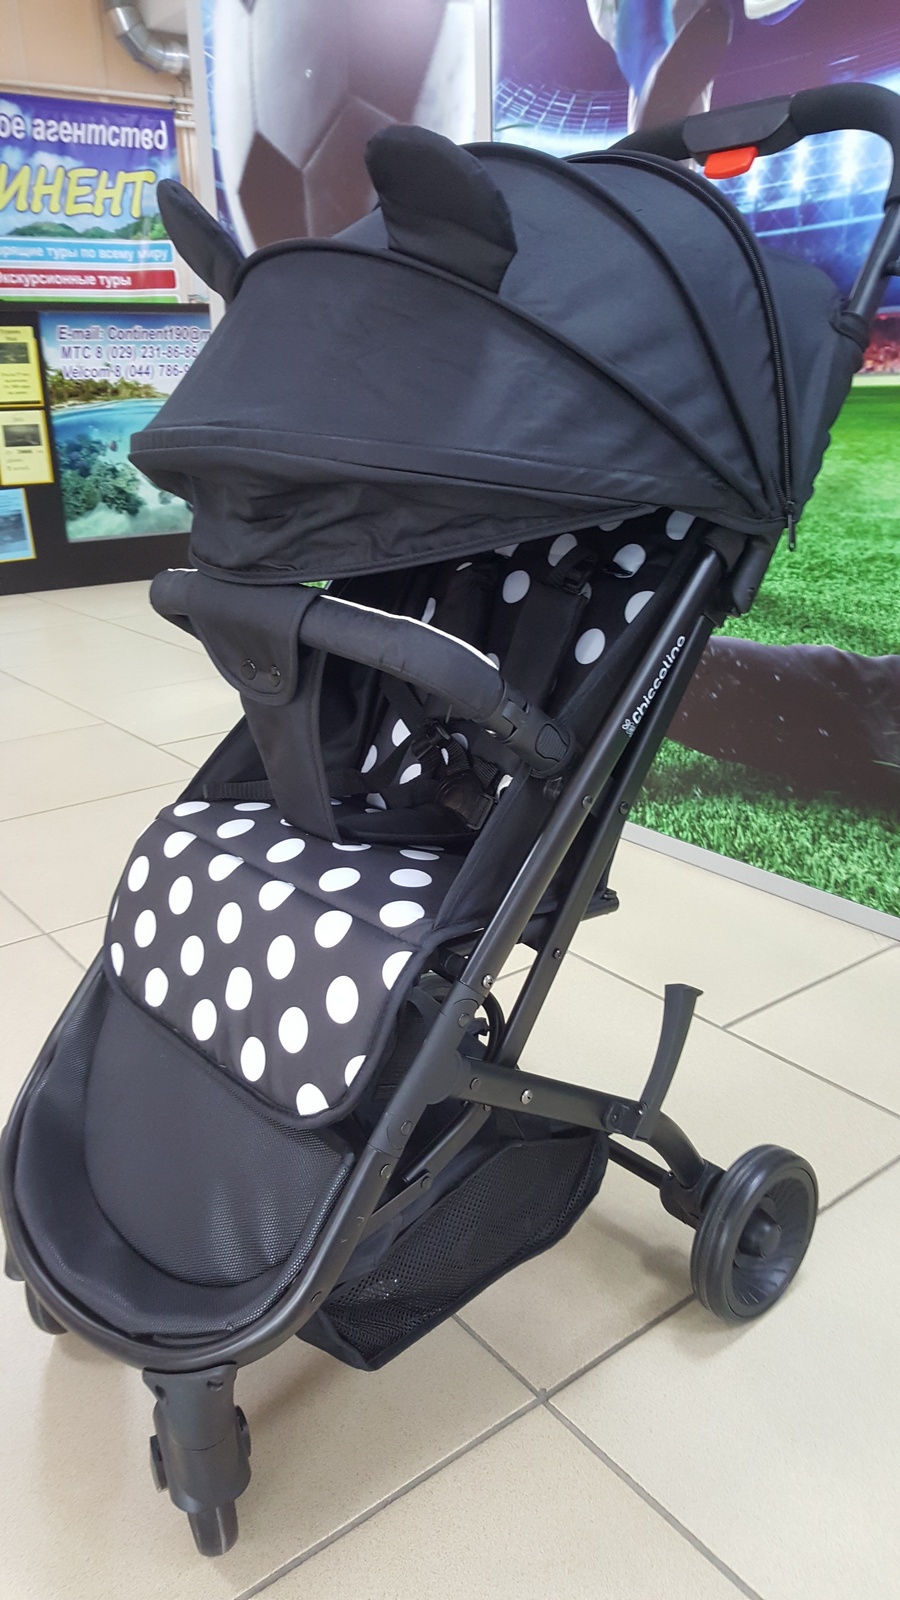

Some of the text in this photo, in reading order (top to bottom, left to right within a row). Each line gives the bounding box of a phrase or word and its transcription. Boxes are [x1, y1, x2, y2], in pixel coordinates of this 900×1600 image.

[0, 162, 156, 218] ИНЕНТ
[46, 247, 78, 260] туры
[81, 248, 96, 259] по
[99, 249, 134, 262] всему
[99, 276, 132, 288] туры
[59, 326, 104, 340] E-mail:
[95, 345, 103, 359] 8
[106, 345, 136, 361] (029)
[61, 364, 110, 378] Velcom
[114, 364, 122, 378] 8
[125, 364, 155, 380] (044)
[632, 635, 686, 724] Chiccolino
